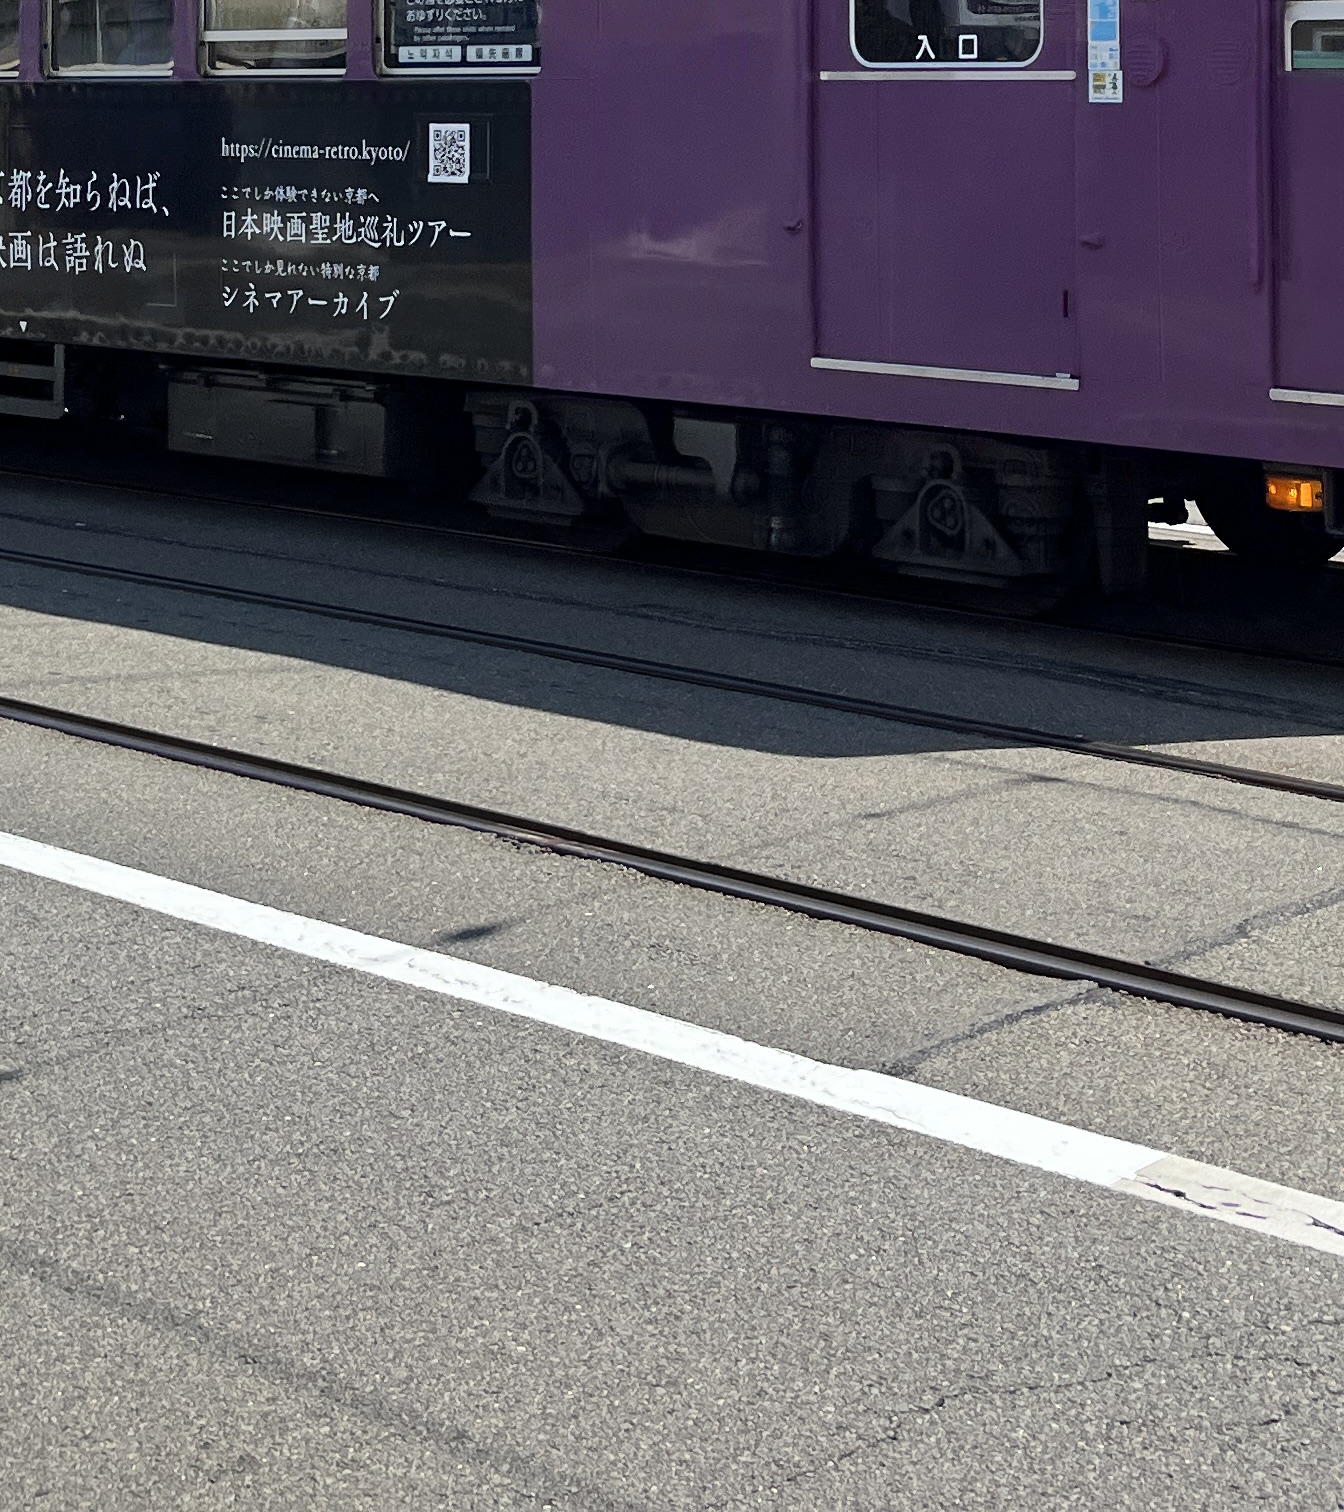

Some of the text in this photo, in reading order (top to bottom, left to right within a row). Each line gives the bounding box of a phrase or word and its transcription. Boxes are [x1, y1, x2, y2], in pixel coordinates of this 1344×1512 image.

[406, 8, 487, 21] おゆずりください。
[915, 34, 978, 60] 入口
[221, 136, 411, 166] https://cinema-retro.kyoto/
[220, 185, 380, 205] ここでしか体験できない京都へ
[222, 207, 472, 249] 日本映画聖地巡礼ツアー
[220, 258, 380, 282] ここでしか見れない特別な京都
[221, 282, 400, 321] シネマアーカイブ
